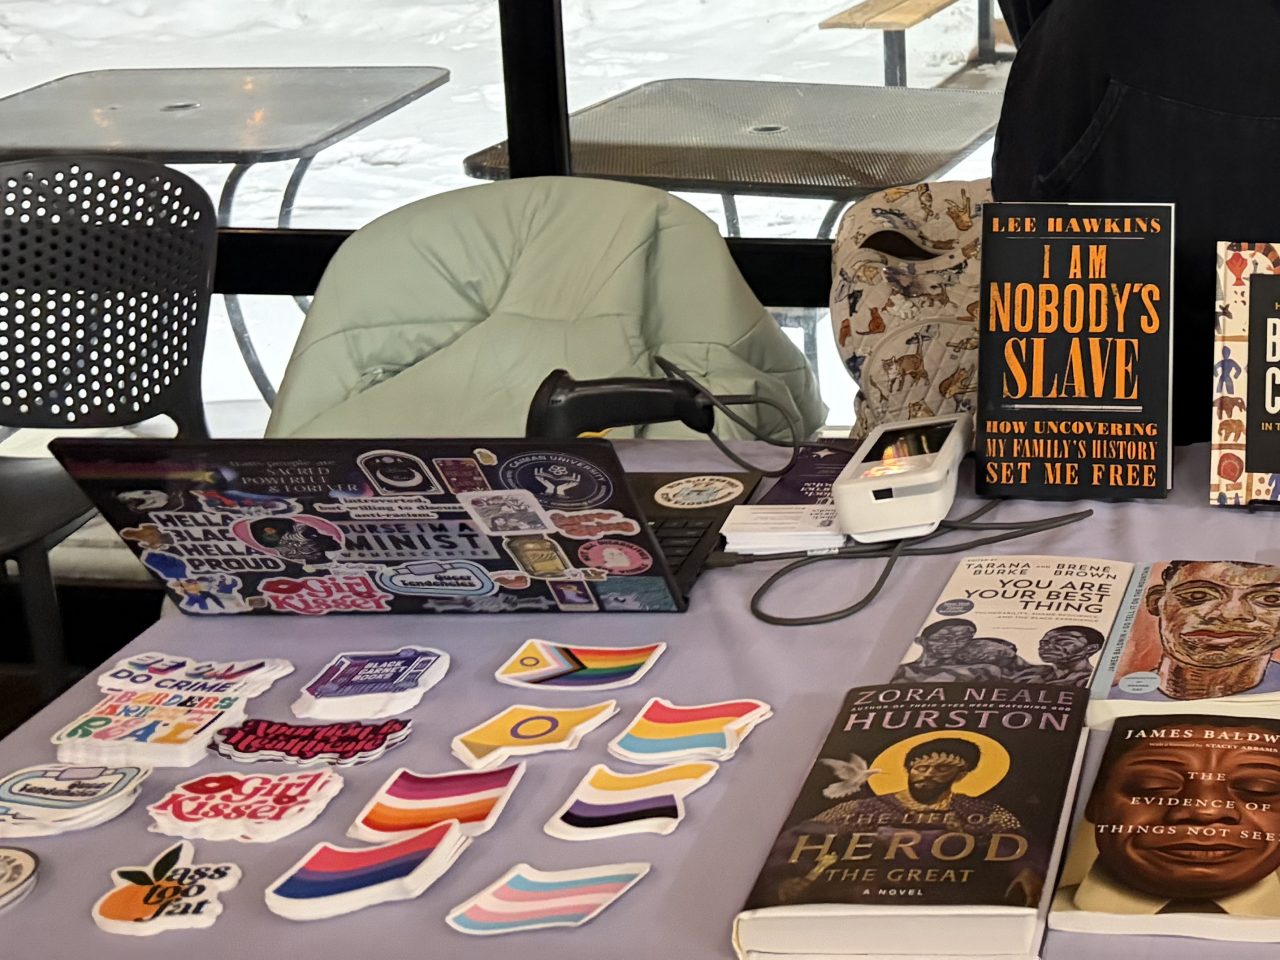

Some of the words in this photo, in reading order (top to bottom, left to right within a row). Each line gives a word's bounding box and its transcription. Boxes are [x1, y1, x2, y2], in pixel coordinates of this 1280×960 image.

[992, 217, 1037, 233] LEE
[1047, 217, 1162, 233] HAWKINS
[1043, 244, 1050, 279] I
[1068, 244, 1107, 279] AM
[989, 282, 1161, 334] NOBODY'S
[1002, 337, 1140, 400] SLAVE
[986, 420, 1028, 435] HOW
[1034, 421, 1158, 437] UNCOVERING
[1261, 422, 1270, 431] IN
[986, 439, 1008, 459] MY
[1013, 439, 1086, 460] FAMILY'S
[1092, 440, 1157, 461] HISTORY
[986, 462, 1030, 485] SET
[1043, 463, 1079, 486] ME
[1092, 463, 1157, 487] FREE
[158, 515, 236, 527] HELLA
[457, 523, 475, 532] A
[345, 534, 481, 551] MINIST
[187, 557, 282, 571] PROUD
[1053, 570, 1117, 580] BROWN
[297, 577, 379, 599] Girl
[999, 579, 1058, 589] YOU
[1060, 581, 1112, 593] ARE
[268, 593, 388, 612] Kisser
[965, 590, 1035, 600] YOUR
[1046, 591, 1111, 603] BEST
[1019, 601, 1103, 614] THING
[358, 666, 408, 675] GARNET
[363, 660, 404, 669] BLACK
[109, 669, 153, 684] DO
[351, 673, 392, 681] BOOKS
[116, 691, 239, 709] BORDERS
[854, 688, 946, 705] ZORA
[964, 688, 1075, 705] NEALE
[843, 710, 1069, 732] HURSTON
[1125, 729, 1194, 740] JAMES
[1187, 772, 1227, 781] THE
[230, 771, 320, 805] Girl
[151, 792, 303, 823] Kisser
[1130, 797, 1236, 809] EVIDENCE
[1245, 802, 1272, 812] OF
[841, 813, 894, 825] THE
[901, 813, 955, 825] LIFE
[1097, 824, 1177, 835] THINGS
[1187, 827, 1231, 838] NOT
[788, 832, 1029, 864] HEROD
[164, 865, 231, 882] ass
[825, 869, 876, 882] THE
[887, 869, 975, 883] GREAT
[142, 882, 207, 906] too
[878, 888, 924, 896] NOVEL
[134, 898, 209, 922] fat
